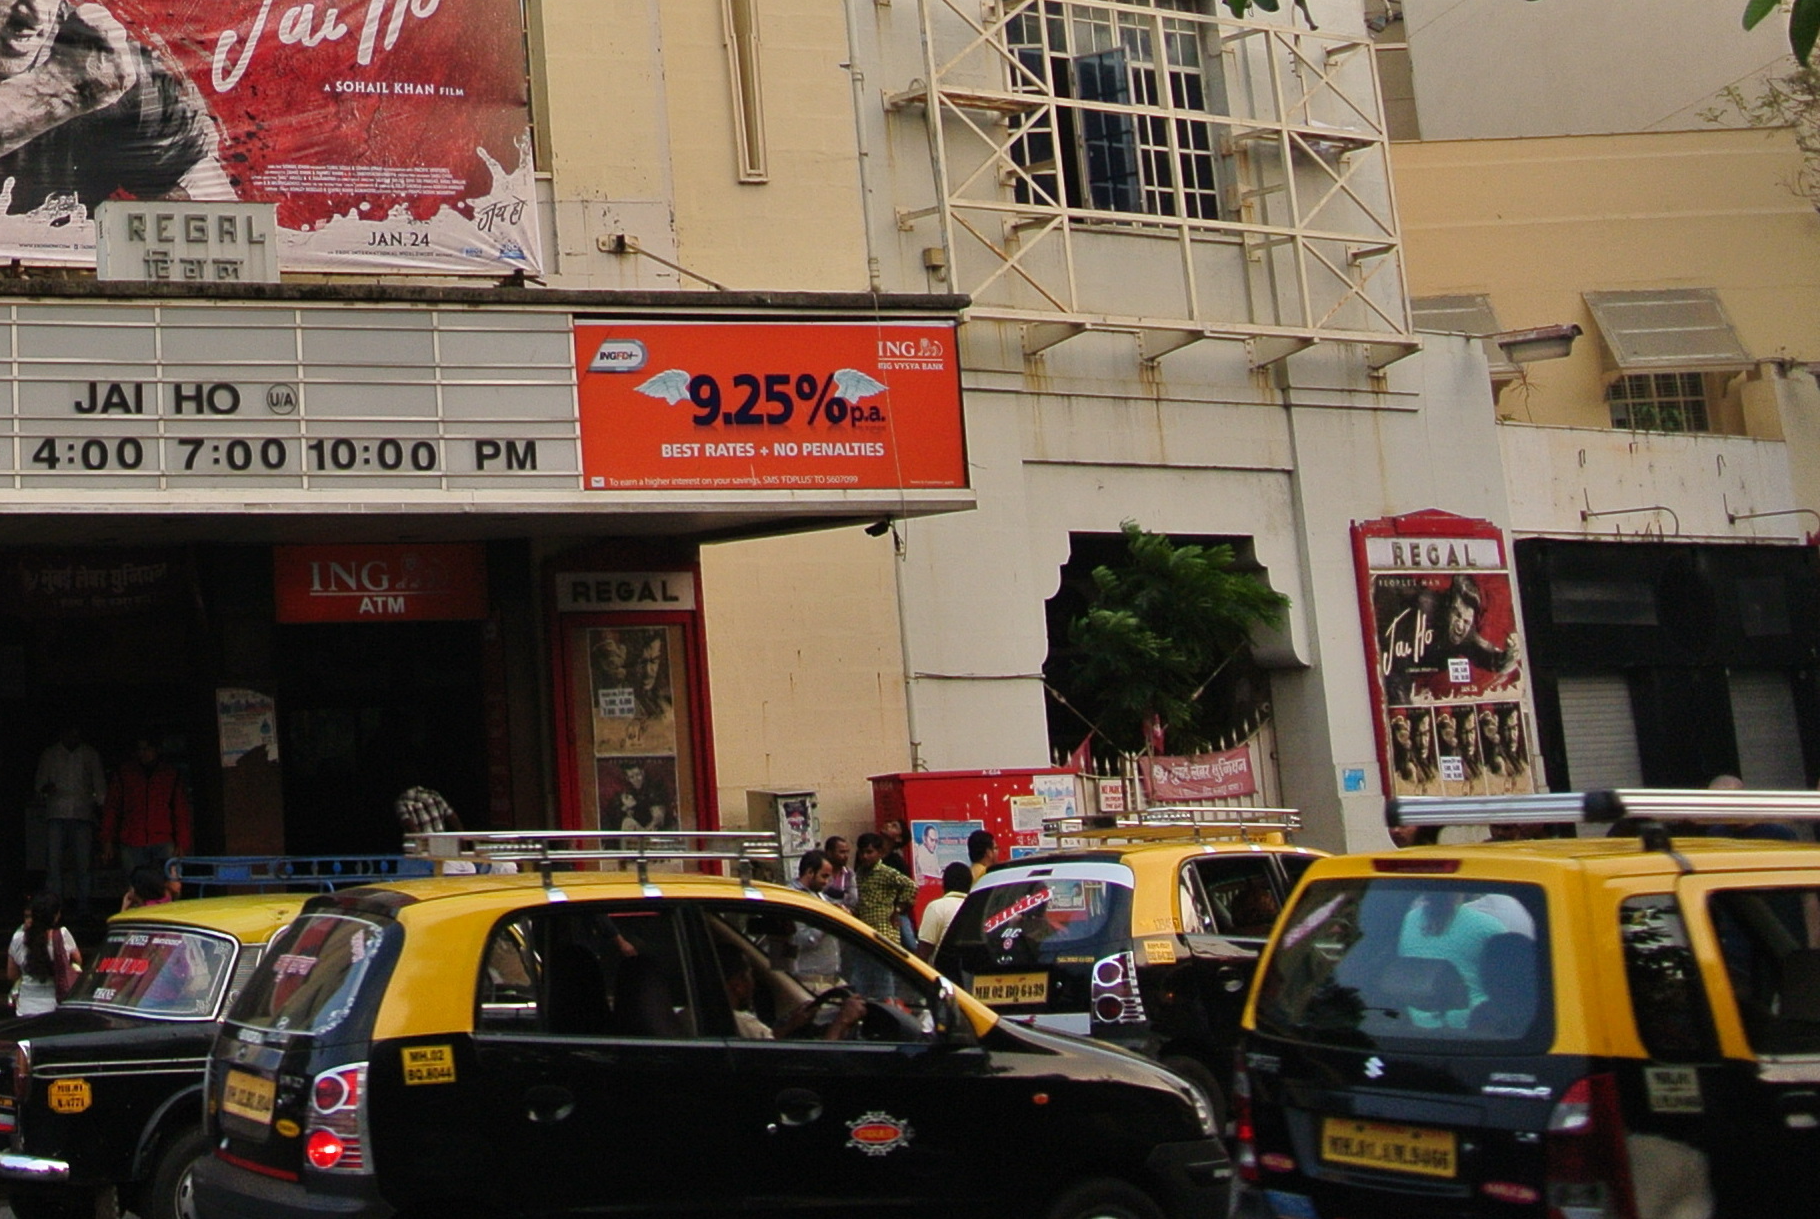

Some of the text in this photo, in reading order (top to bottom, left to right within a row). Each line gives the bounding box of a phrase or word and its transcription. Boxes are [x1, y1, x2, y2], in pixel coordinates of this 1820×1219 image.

[335, 81, 390, 93] SOHAIL
[394, 83, 434, 95] KHAN
[439, 87, 464, 96] FILM
[128, 213, 266, 244] REGAL
[877, 341, 915, 357] ING
[894, 362, 920, 371] VYSYA
[922, 362, 944, 371] BANK
[75, 382, 144, 415] JAI
[175, 383, 240, 415] HO
[688, 374, 885, 427] 9.25% p.a.
[32, 436, 144, 471] 4:00
[181, 437, 286, 471] 7:00
[308, 438, 437, 471] 10:00
[476, 439, 538, 471] PM
[661, 443, 701, 458] BEST
[705, 443, 755, 457] RATES
[773, 443, 798, 457] NO
[802, 442, 885, 457] PENALTIES
[609, 478, 619, 486] To
[645, 477, 666, 488] higher
[671, 477, 700, 486] interest
[714, 478, 731, 487] your
[763, 475, 779, 484] SMS
[814, 475, 825, 484] TO
[826, 475, 858, 483] 5607099
[1391, 541, 1477, 567] REGAL
[309, 560, 389, 592] ING
[572, 580, 680, 603] REGAL
[359, 596, 405, 614] ATM
[1383, 607, 1434, 675] Jai Ho
[991, 985, 1002, 998] 02
